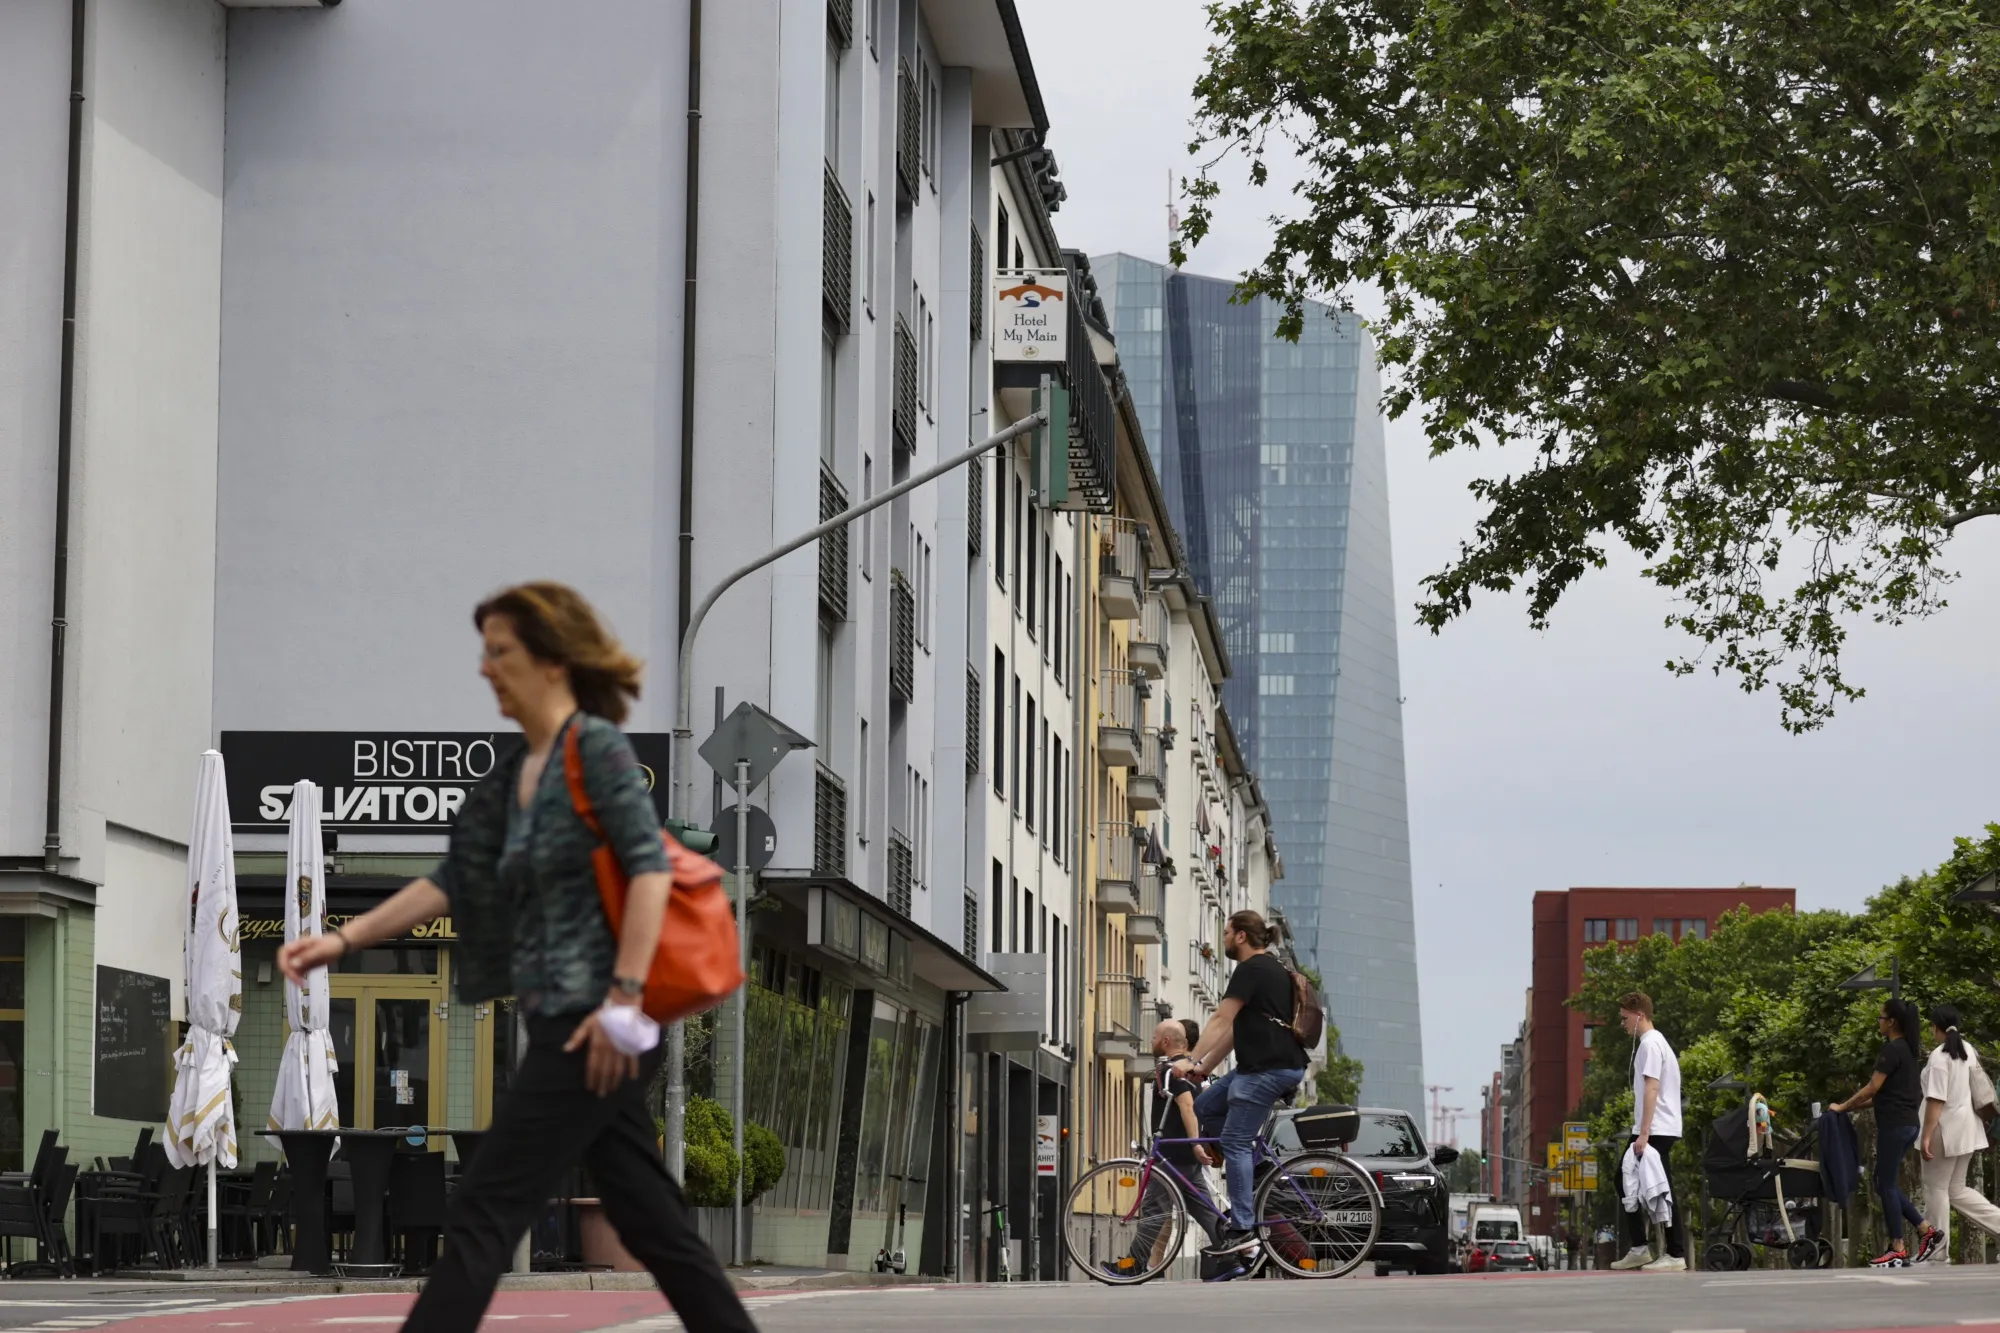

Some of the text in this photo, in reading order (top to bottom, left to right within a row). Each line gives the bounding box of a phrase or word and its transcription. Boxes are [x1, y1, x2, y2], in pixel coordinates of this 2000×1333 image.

[1014, 313, 1047, 326] Hotel
[1003, 328, 1058, 344] My Main
[1350, 1212, 1373, 1223] 2108
